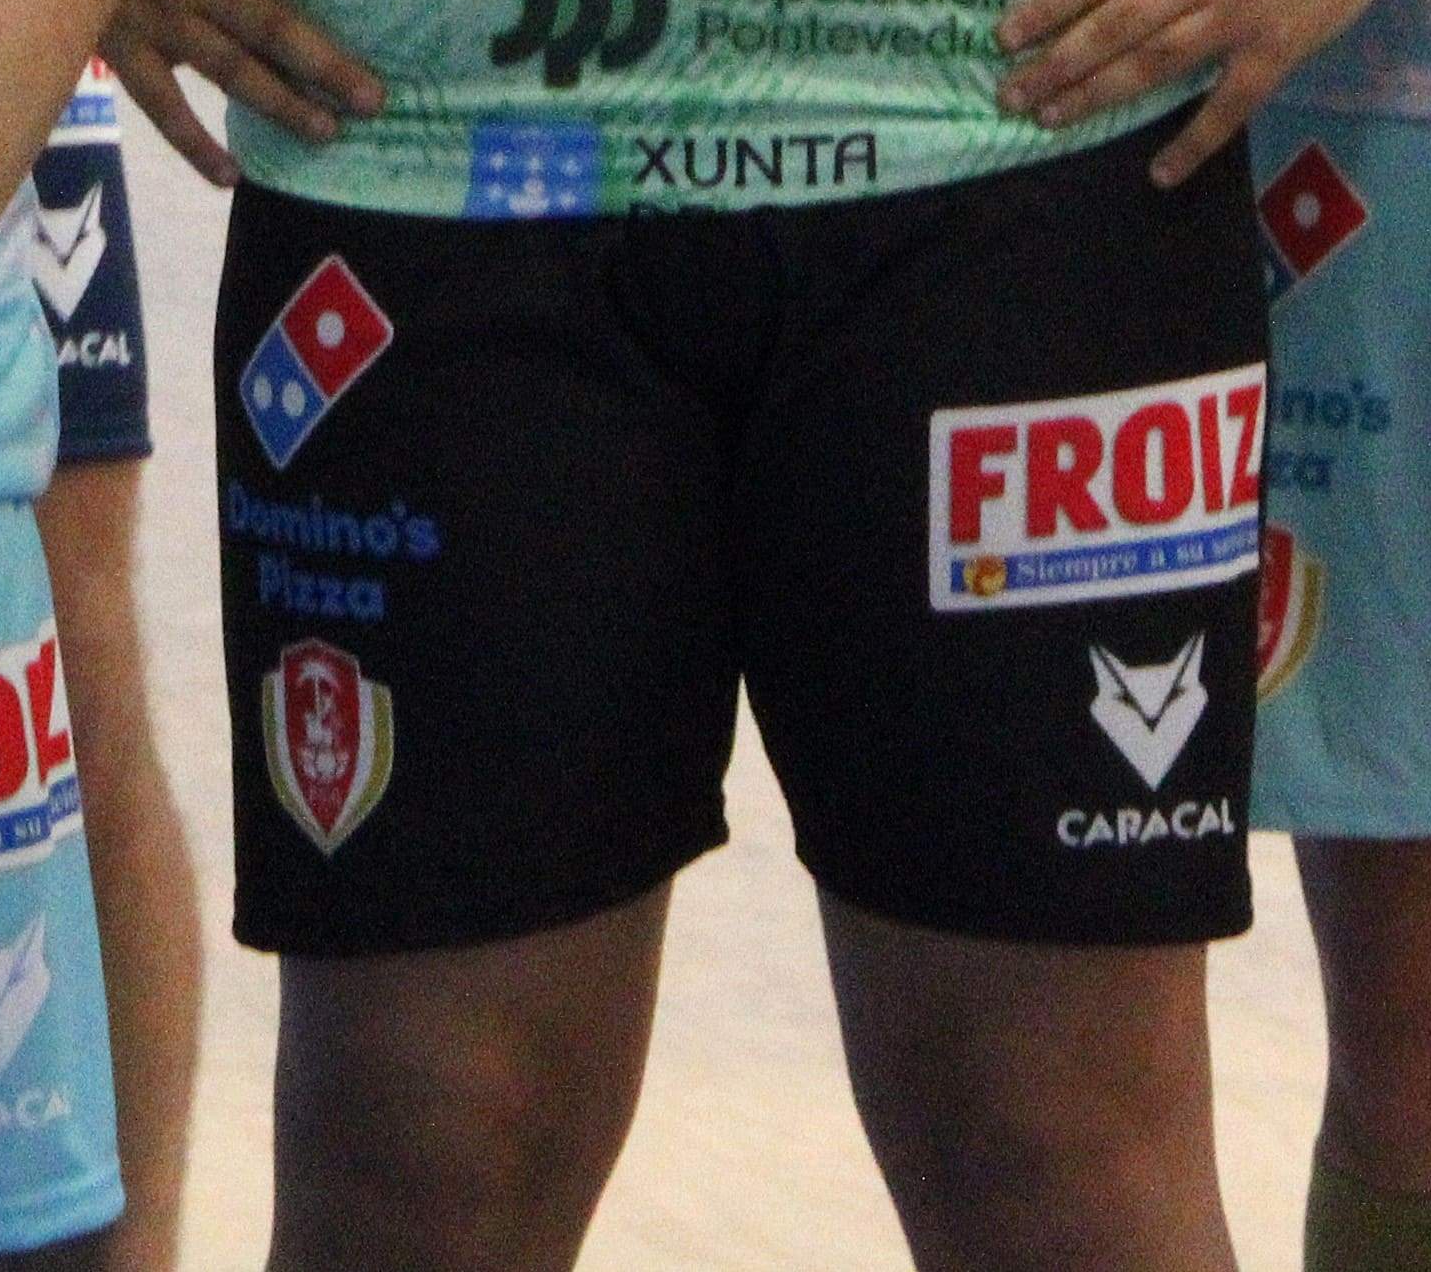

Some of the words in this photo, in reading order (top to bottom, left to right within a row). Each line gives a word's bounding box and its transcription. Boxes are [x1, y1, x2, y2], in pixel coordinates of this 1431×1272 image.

[629, 131, 879, 189] XUNTA
[949, 383, 1263, 544] FROIZ
[225, 478, 443, 562] Domino's
[256, 552, 387, 622] Pizza
[1056, 796, 1235, 847] CARACAL
